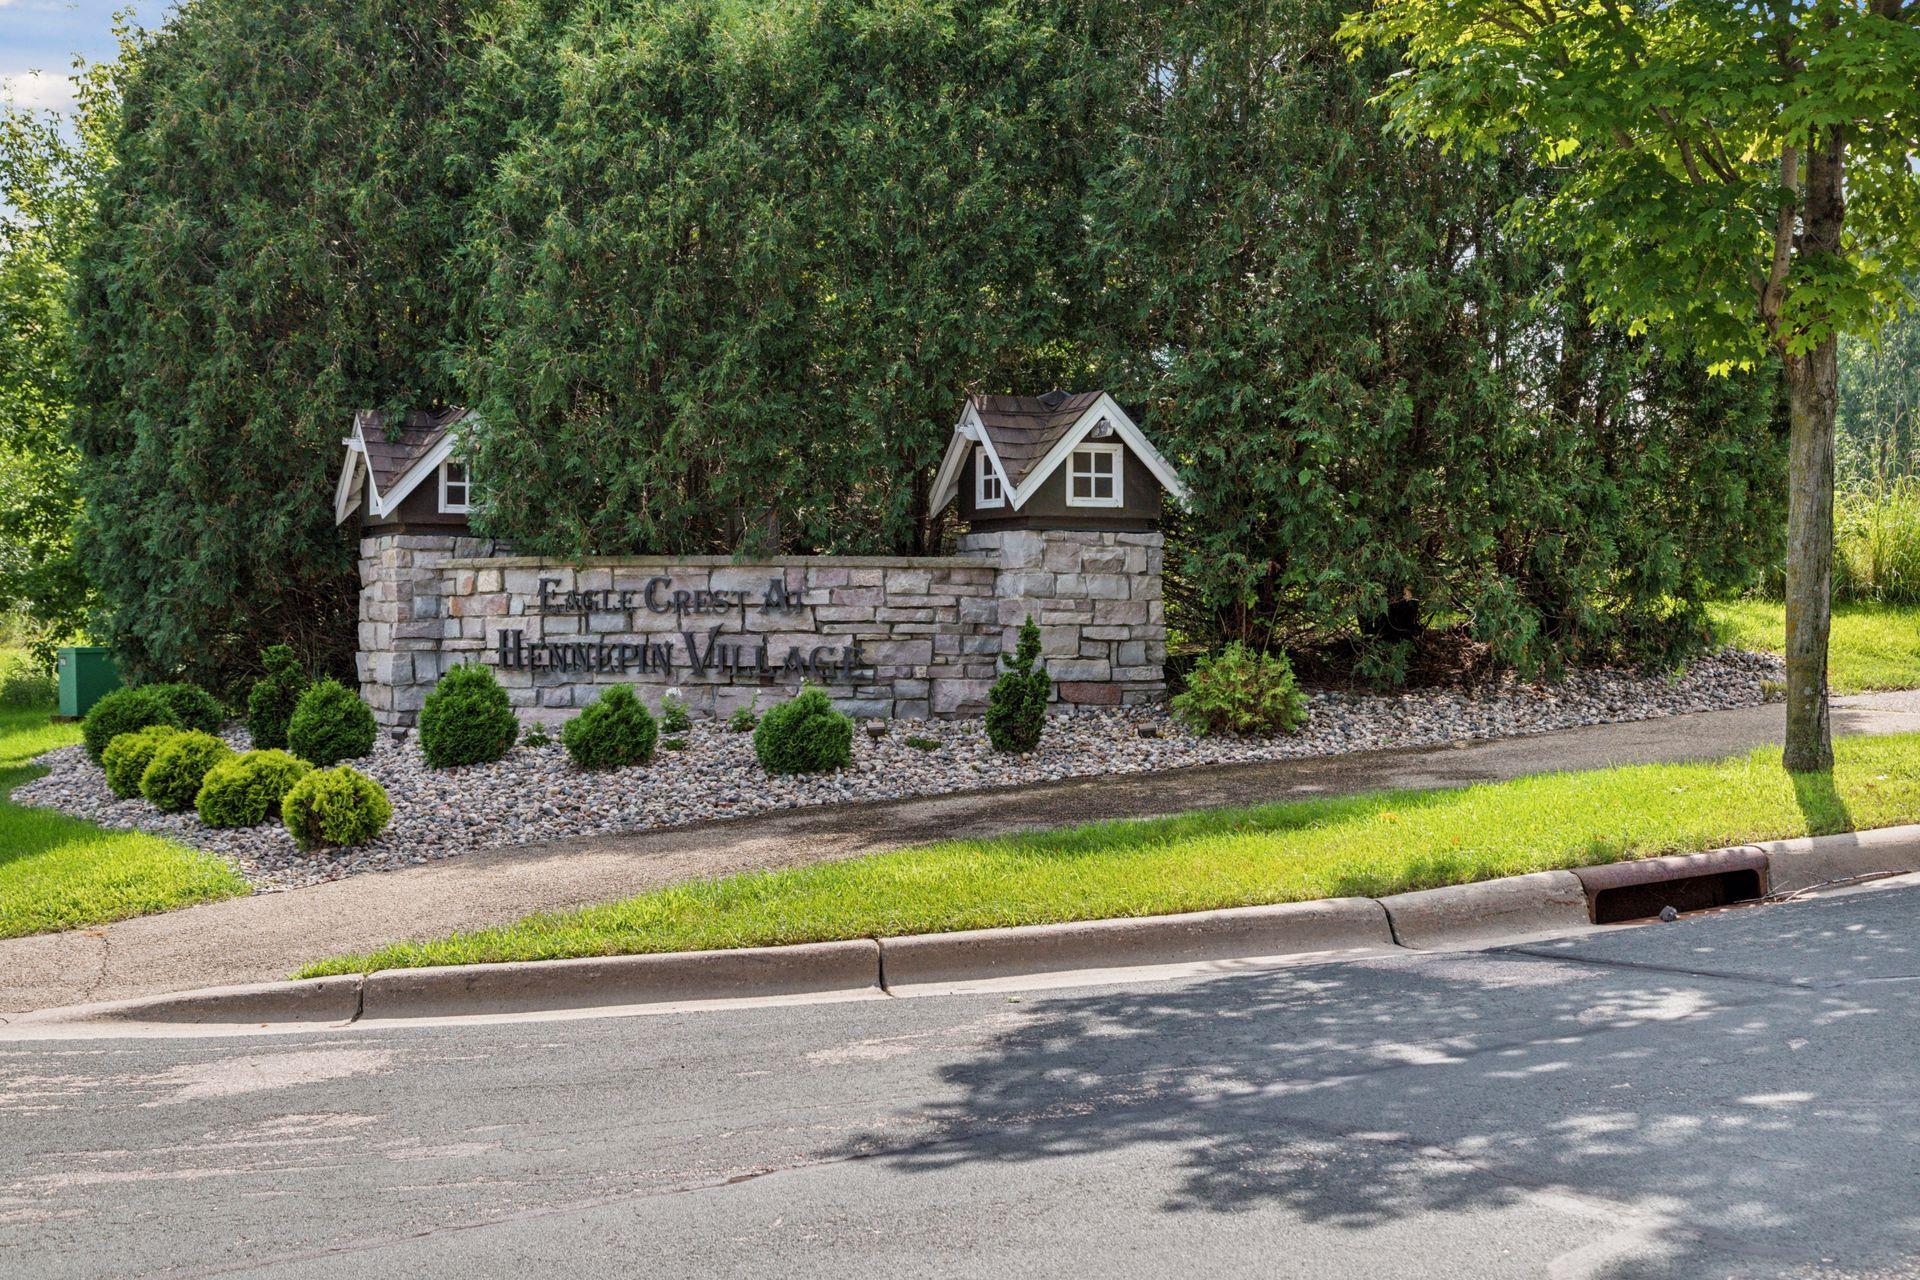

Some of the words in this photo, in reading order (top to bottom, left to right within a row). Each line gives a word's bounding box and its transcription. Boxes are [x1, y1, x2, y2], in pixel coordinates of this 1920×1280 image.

[537, 577, 636, 614] EAGLE
[643, 576, 751, 615] CREST
[758, 578, 808, 615] AT
[496, 628, 674, 676] HENNEPIN
[682, 622, 866, 680] VILLAGE
